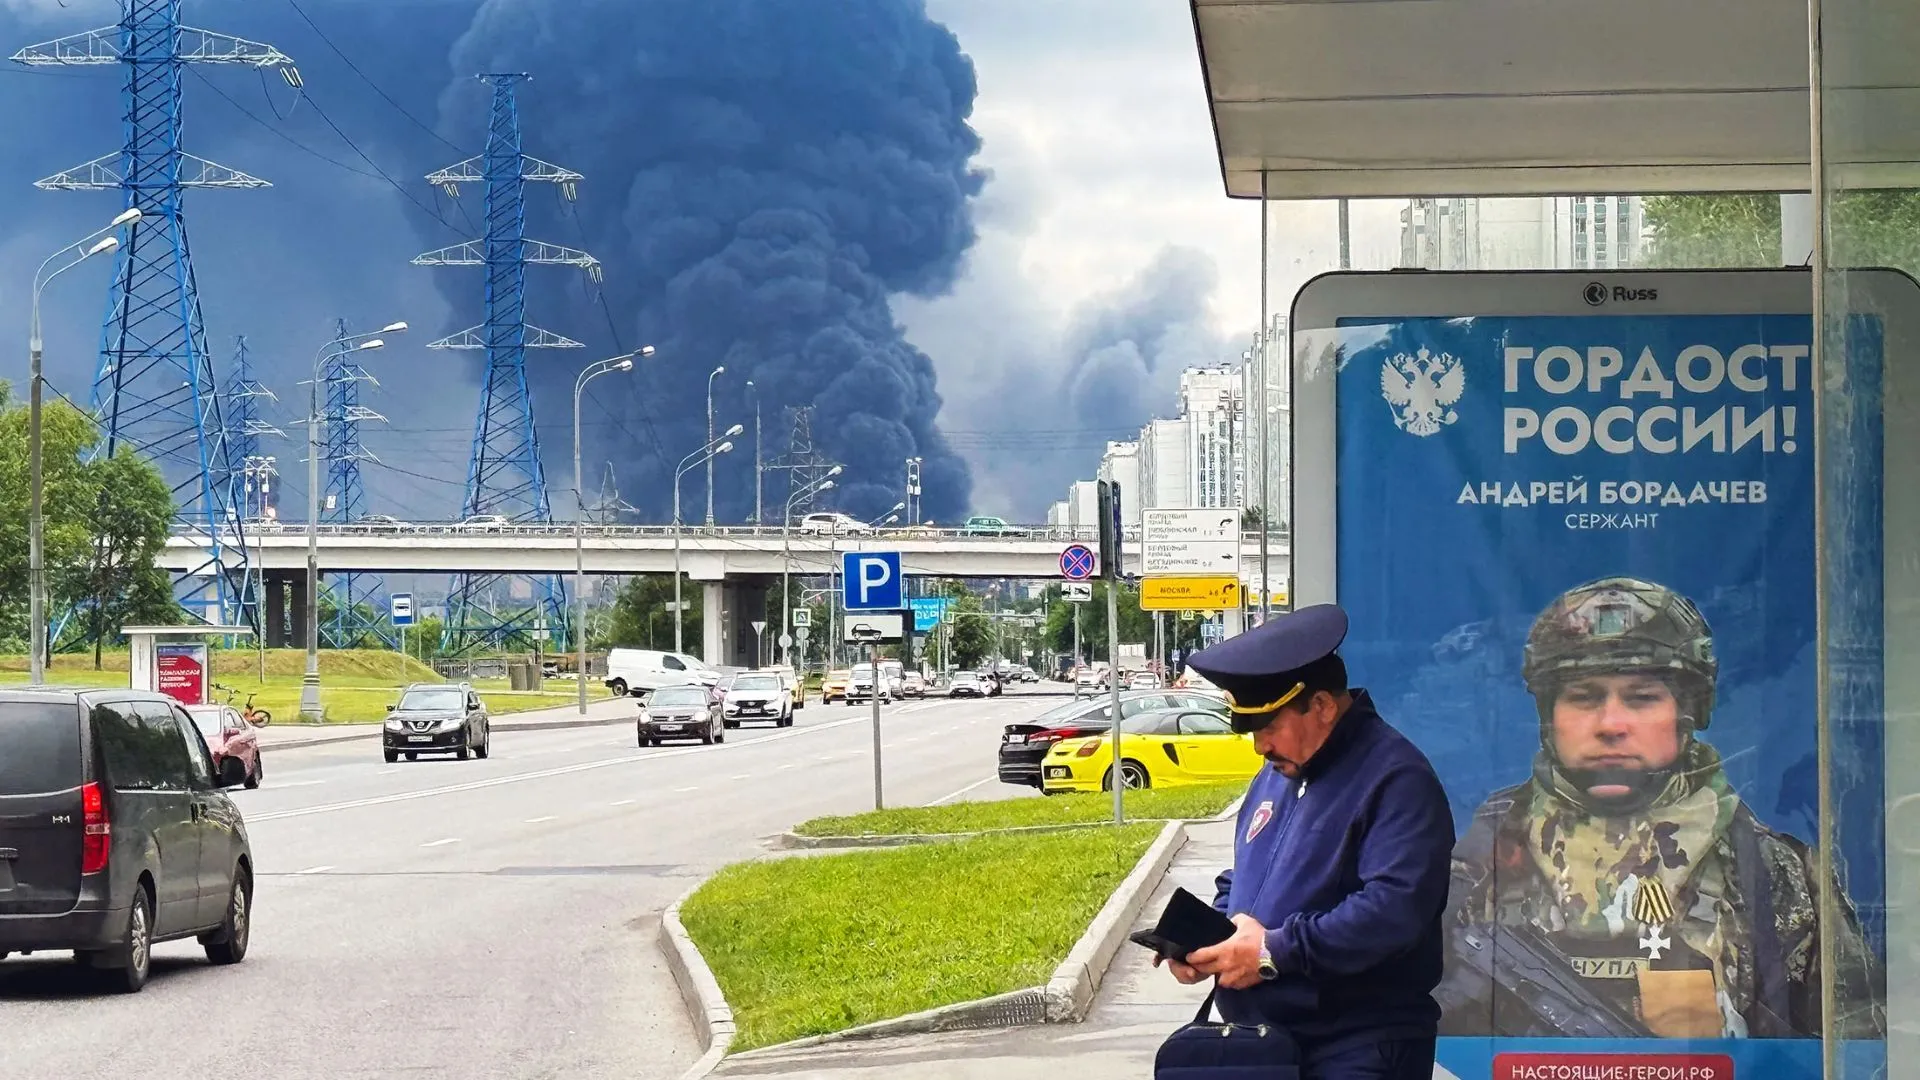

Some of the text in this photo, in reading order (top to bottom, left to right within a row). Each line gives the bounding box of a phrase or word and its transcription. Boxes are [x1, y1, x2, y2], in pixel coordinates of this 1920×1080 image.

[1612, 286, 1658, 301] Russ
[1503, 344, 1815, 399] ГОРДОСТ
[1503, 405, 1797, 455] РОССИИ!
[1456, 475, 1768, 507] АНДРЕЙ БОРДАЧЕВ
[1565, 512, 1659, 530] СЕРЖАНТ
